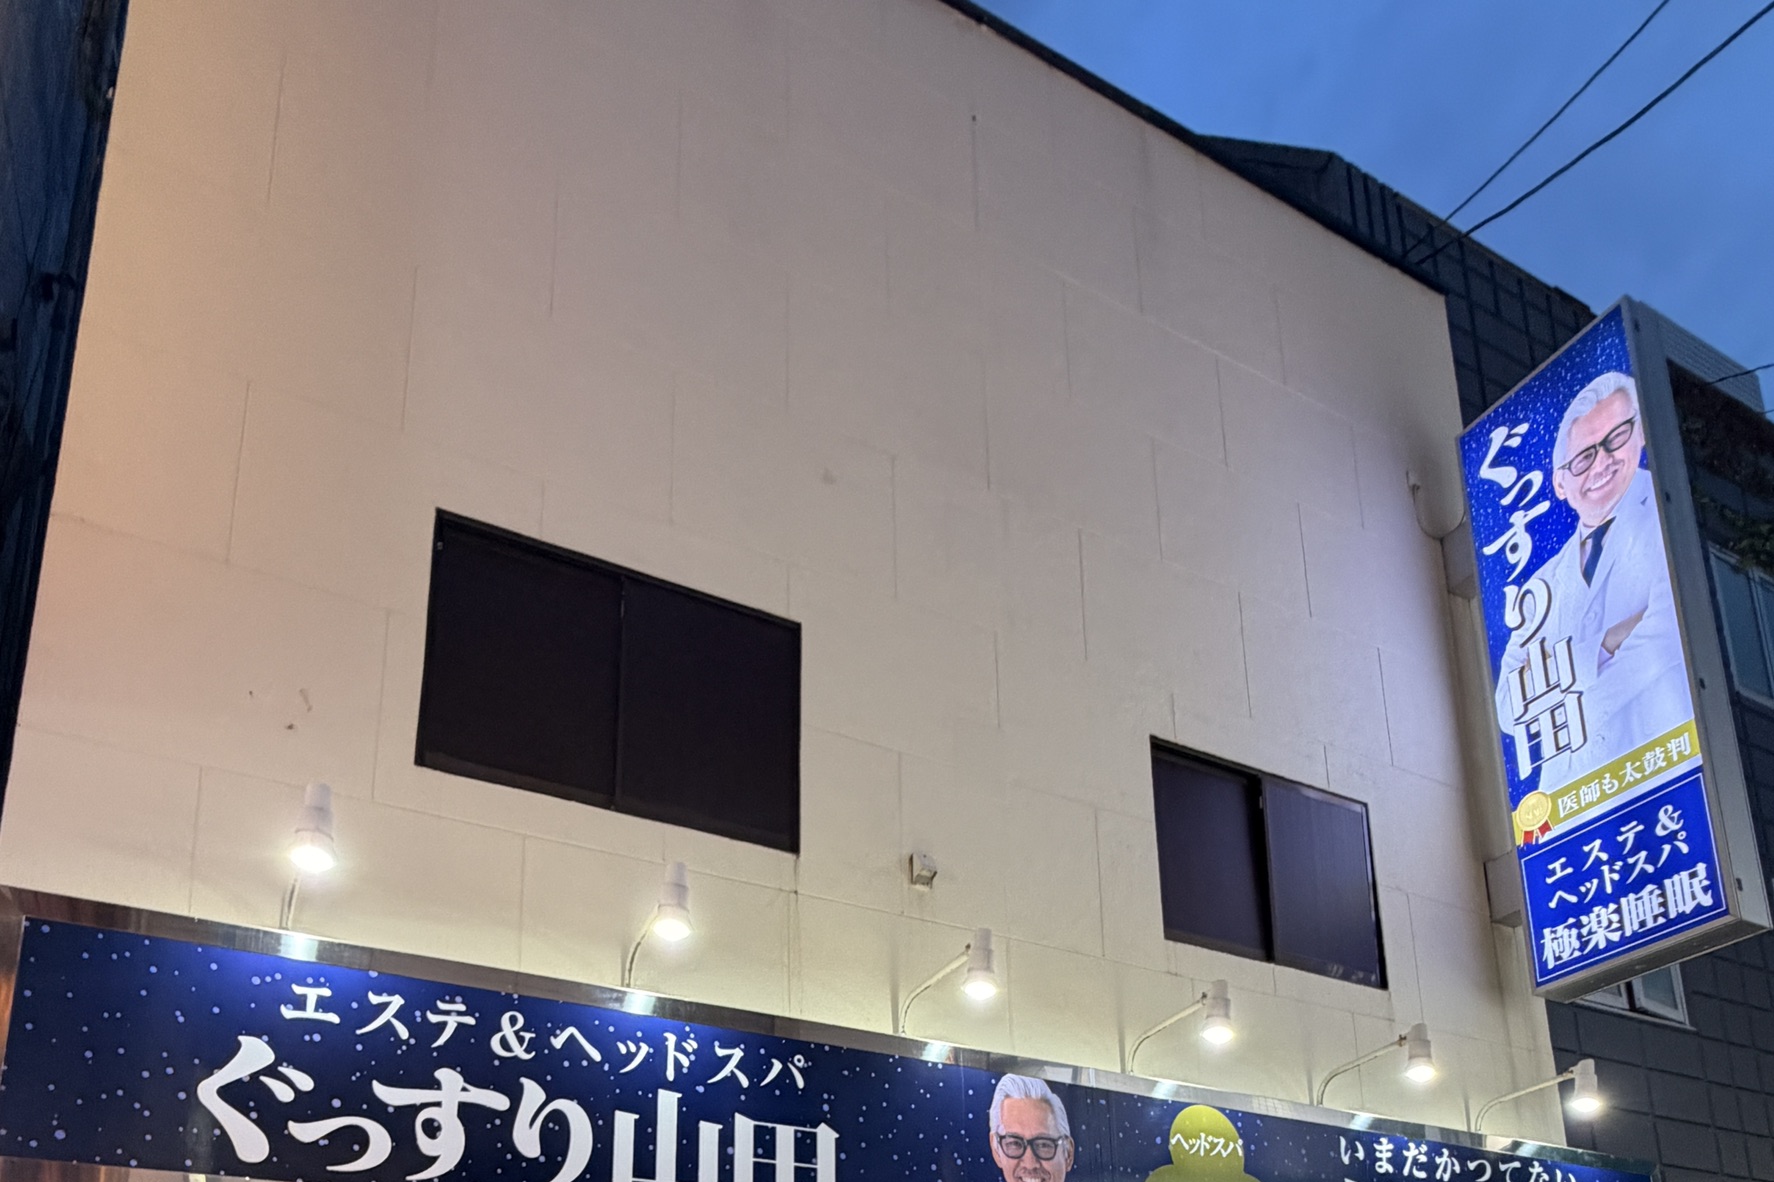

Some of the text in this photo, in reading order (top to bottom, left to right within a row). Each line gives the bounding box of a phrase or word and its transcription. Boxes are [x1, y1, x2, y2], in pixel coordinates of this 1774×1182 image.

[1479, 422, 1587, 780] ぐっすり山田
[1557, 732, 1690, 818] 医師も太鼓判
[1545, 804, 1684, 884] エステ&
[1549, 831, 1690, 909] ヘッドスパ
[1540, 862, 1713, 969] 極楽睡眠
[1171, 1132, 1244, 1158] ヘッドスパ
